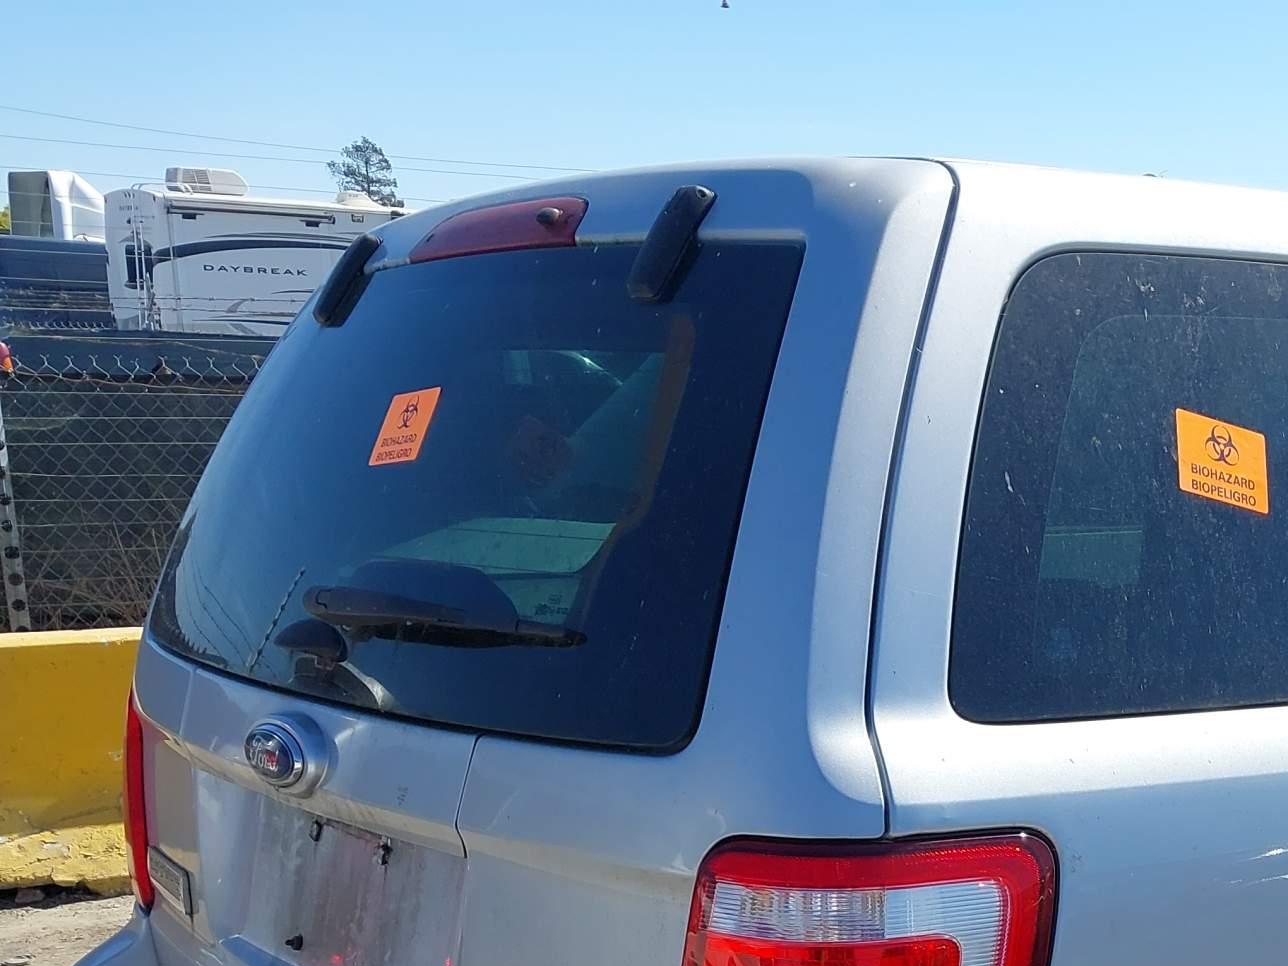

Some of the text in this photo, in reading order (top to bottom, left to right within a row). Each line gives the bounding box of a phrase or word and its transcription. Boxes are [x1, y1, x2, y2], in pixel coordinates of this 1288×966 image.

[203, 264, 308, 277] DAYBREAK
[1190, 463, 1255, 491] BIOHAZARD
[1191, 479, 1257, 507] BIOPELIGRO
